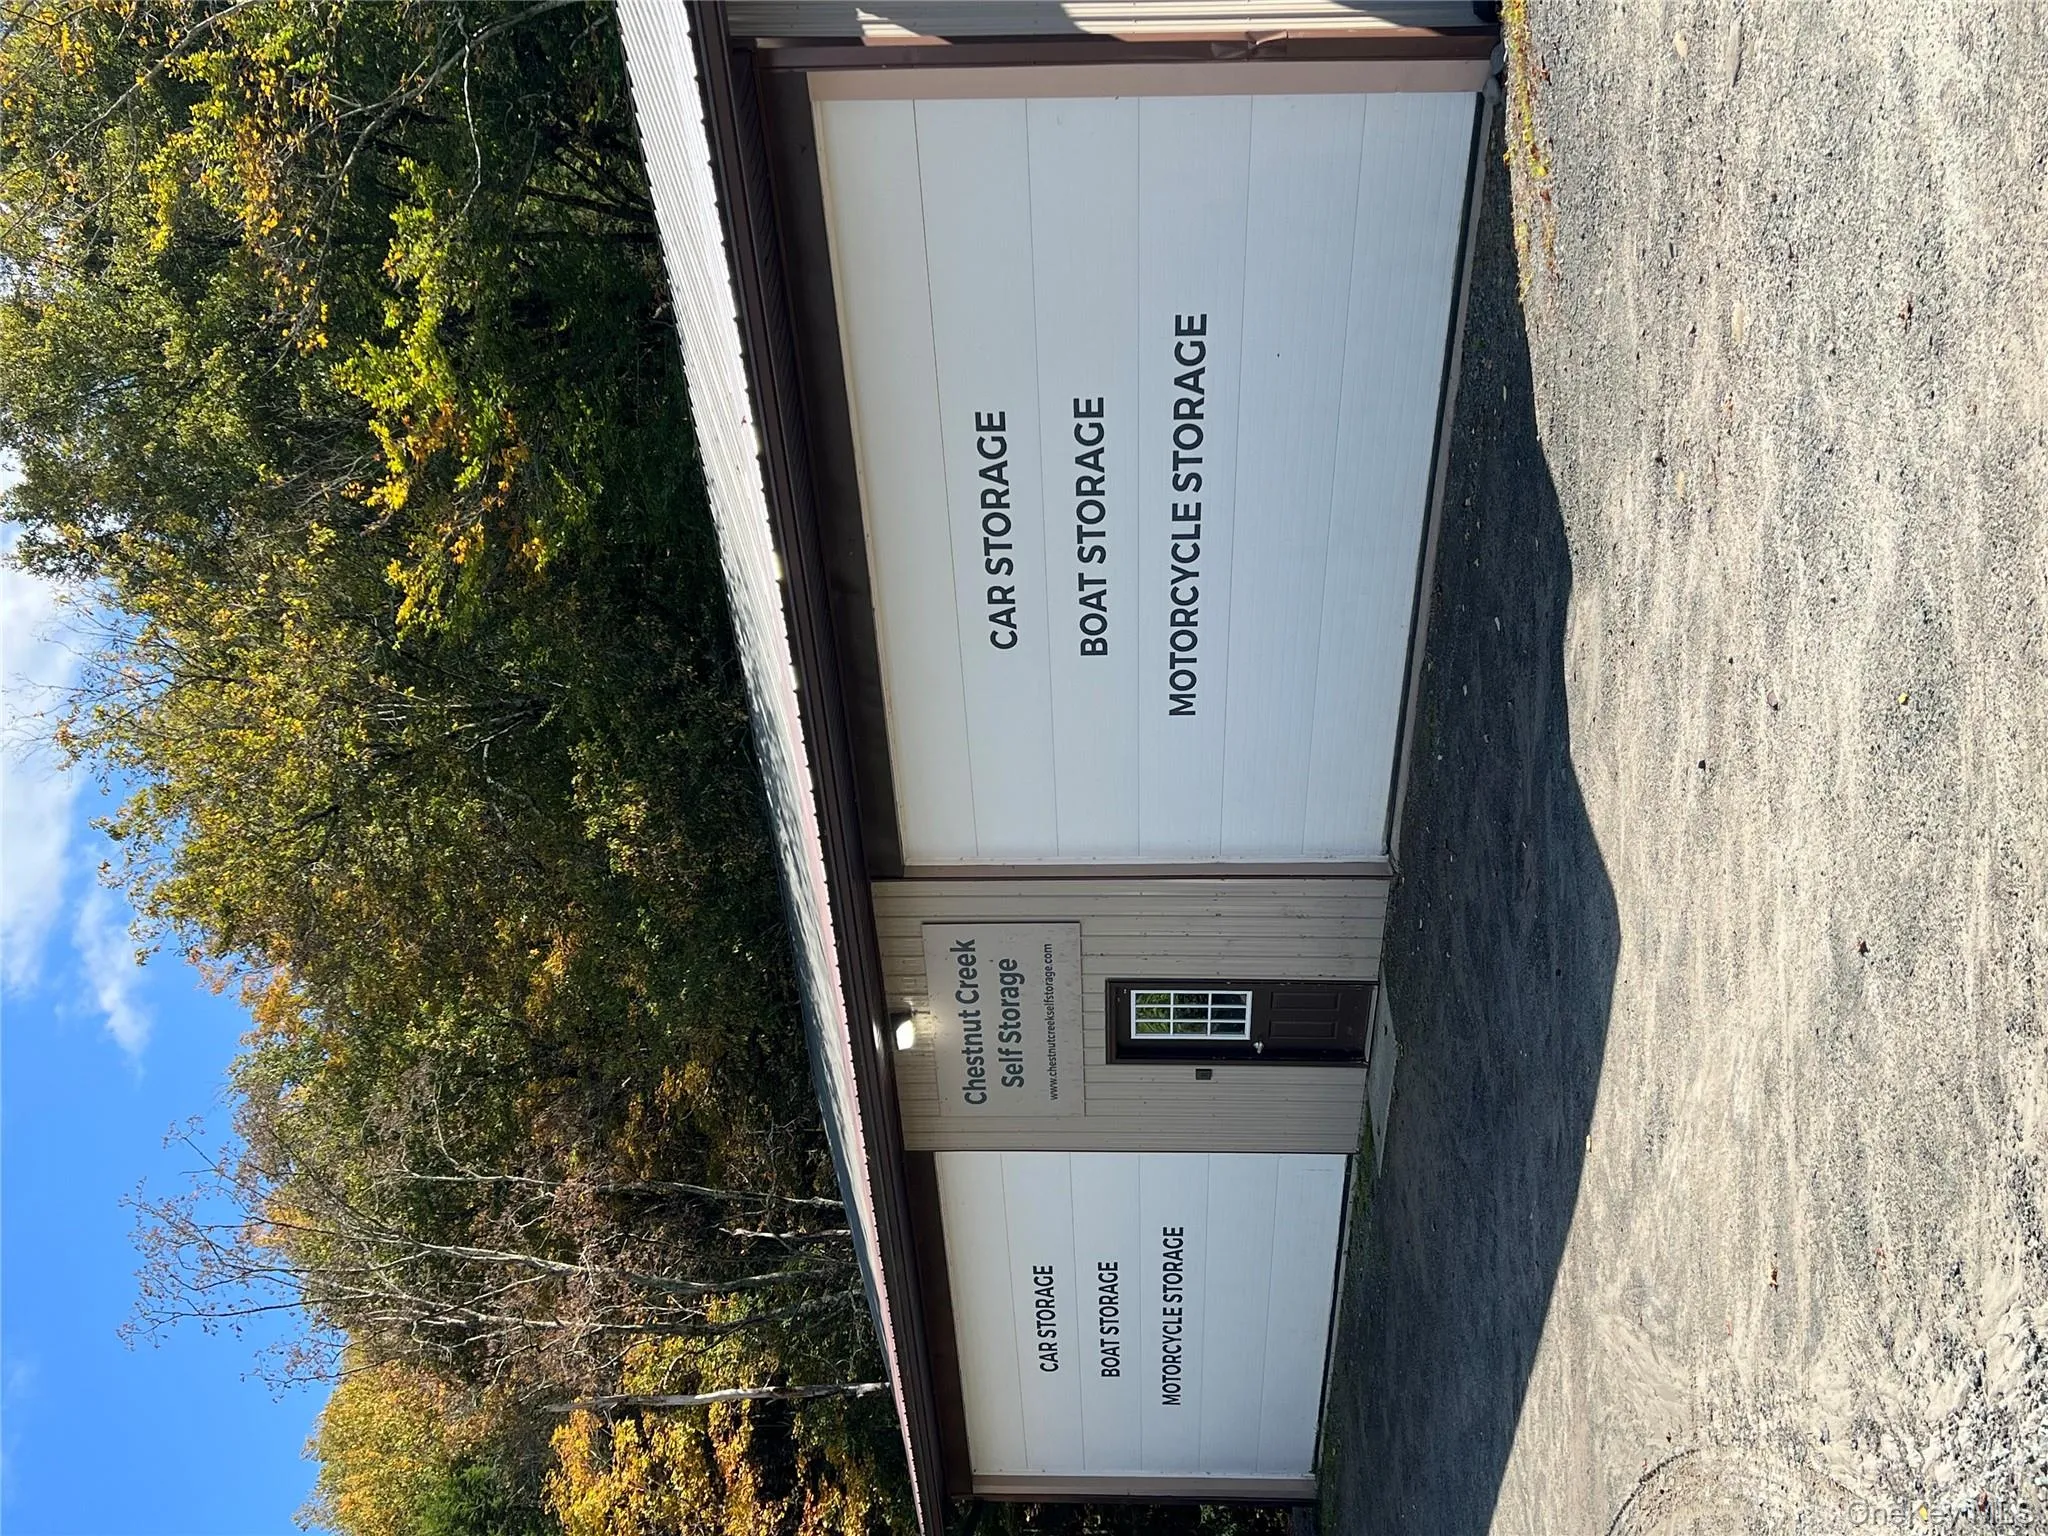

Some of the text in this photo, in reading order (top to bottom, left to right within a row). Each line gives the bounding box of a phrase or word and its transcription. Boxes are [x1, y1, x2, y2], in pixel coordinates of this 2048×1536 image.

[974, 411, 1018, 650] CAR STORAGE
[1073, 397, 1108, 657] BOAT STORAGE
[1168, 313, 1208, 716] MOTORCYCLE STORAGE
[949, 938, 988, 1105] Chestnut Creek
[998, 958, 1026, 1089] Self Storage
[1042, 943, 1060, 1102] www.chestnutcreekselfstorage.com
[1032, 1265, 1059, 1373] CAR STORAGE
[1097, 1261, 1121, 1378] BOAT STORAGE
[1161, 1226, 1184, 1406] MOTORCYCLE STORAGE
